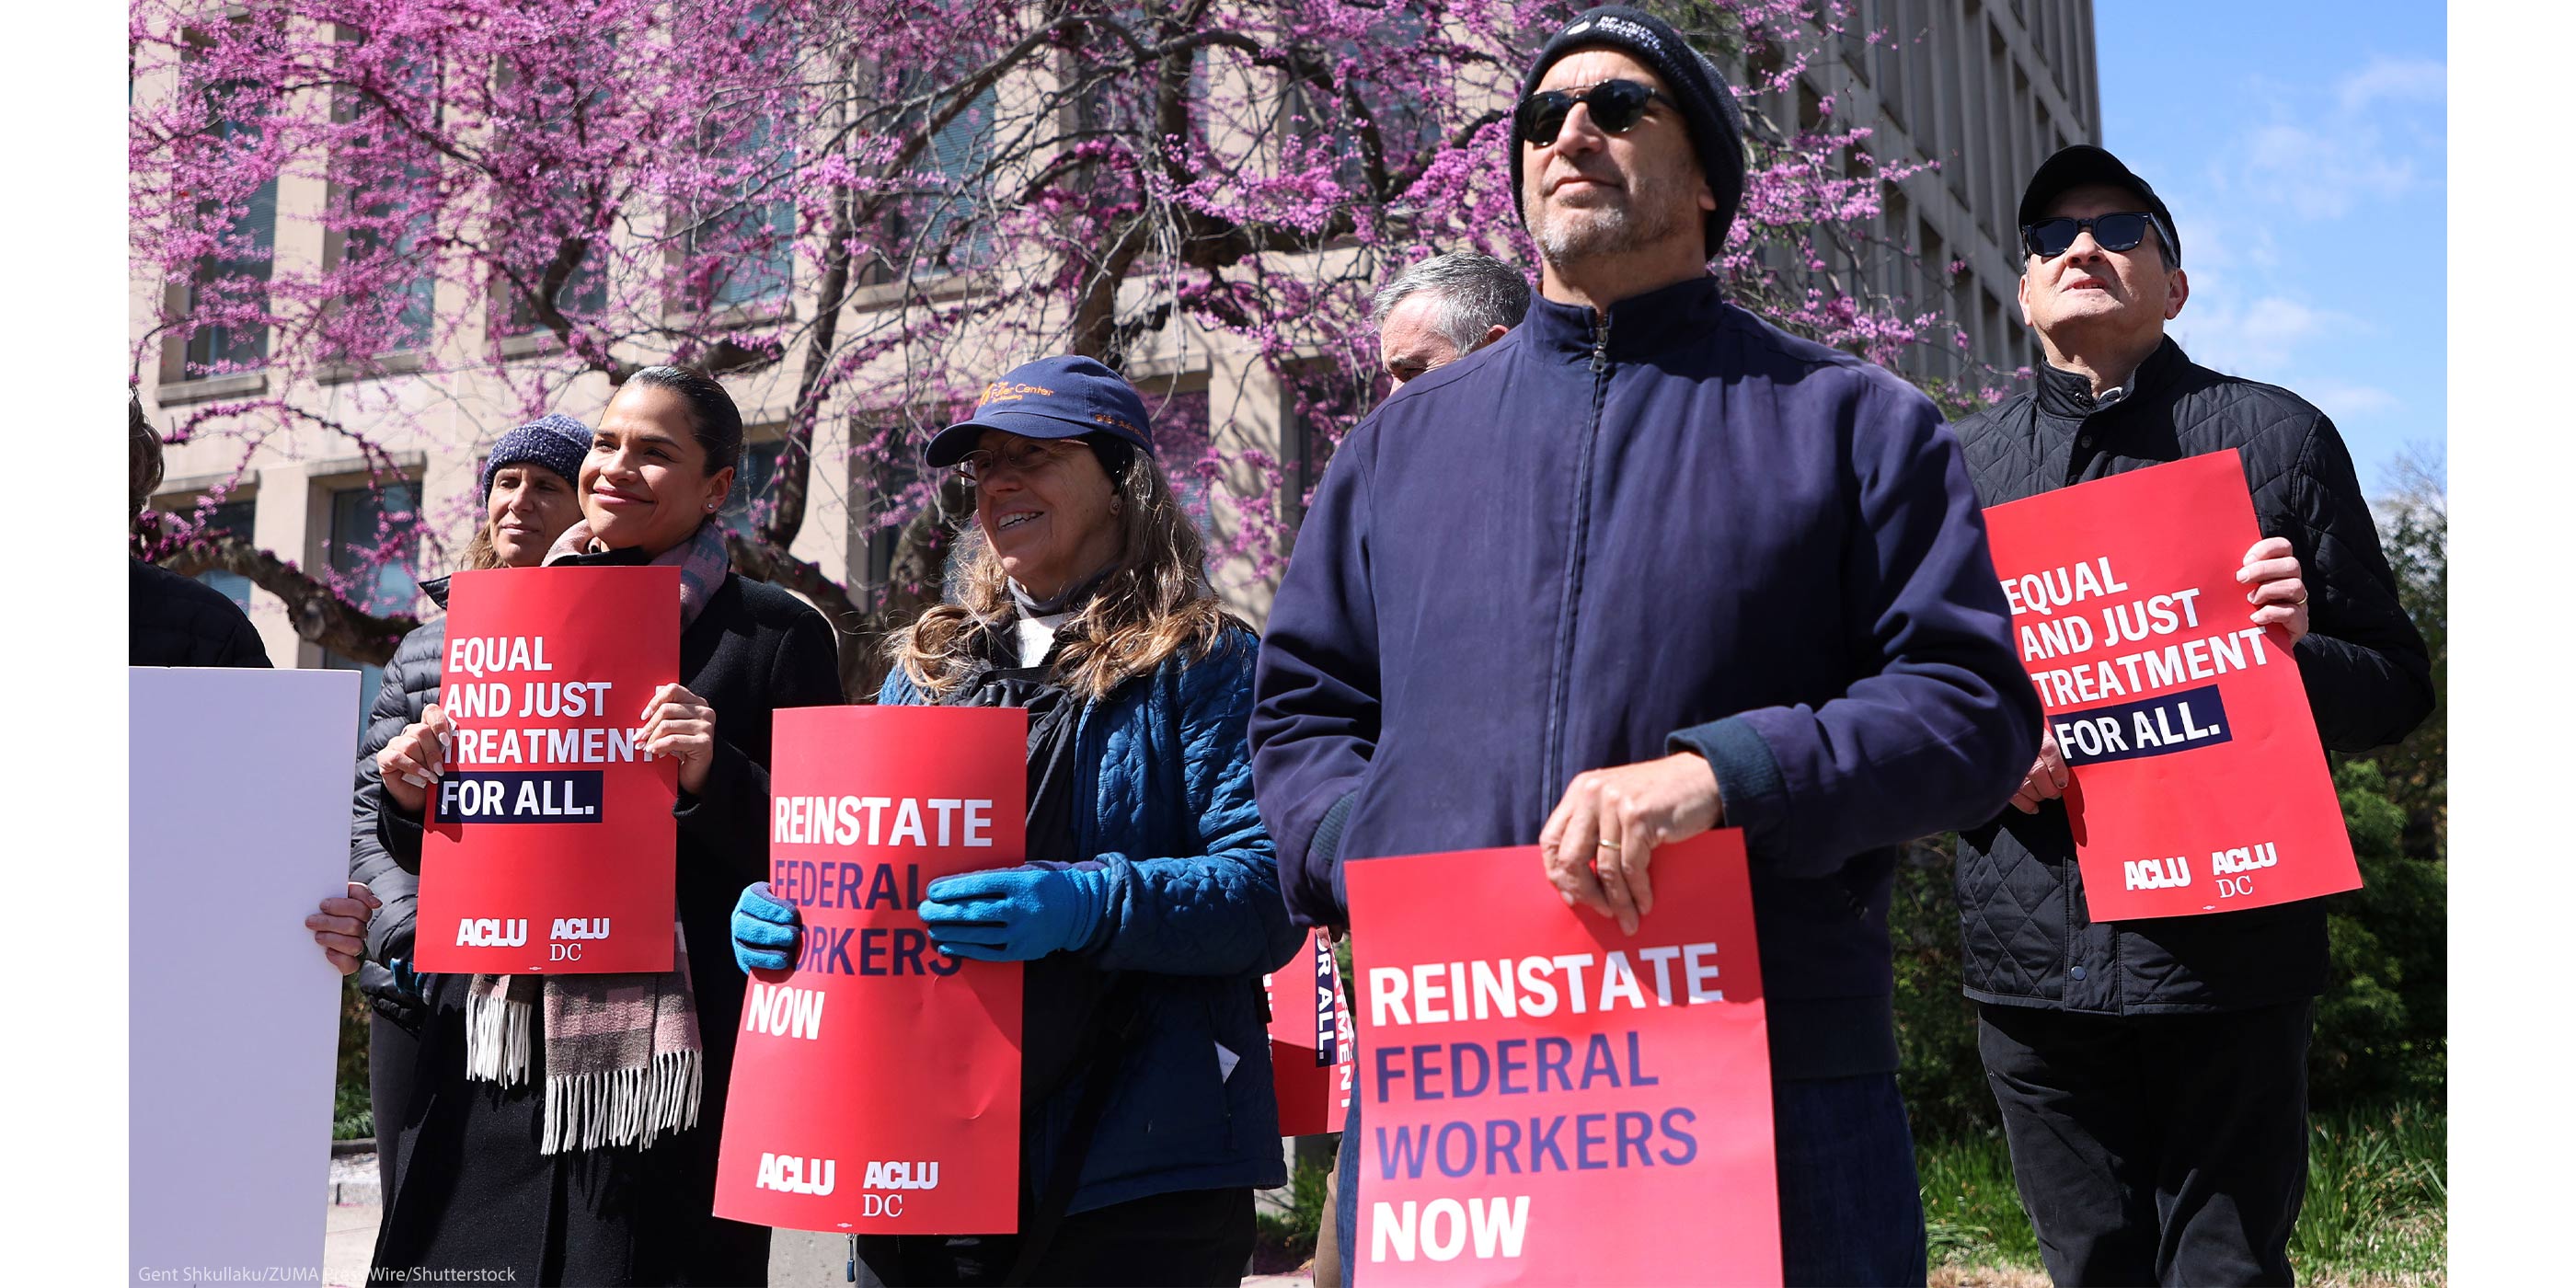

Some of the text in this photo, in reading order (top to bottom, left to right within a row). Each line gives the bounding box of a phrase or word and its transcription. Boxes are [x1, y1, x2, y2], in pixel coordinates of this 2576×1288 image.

[1015, 383, 1054, 397] Center
[1999, 556, 2129, 615] EQUAL
[2020, 588, 2201, 662] AND JUST
[448, 636, 553, 679] EQUAL
[2030, 626, 2270, 708] TREATMENT
[443, 682, 612, 719] AND JUST
[2053, 701, 2221, 760] FOR ALL.
[441, 779, 594, 816] FOR ALL.
[774, 795, 993, 847] REINSTATE
[2123, 856, 2191, 891] ACLU
[2212, 842, 2278, 876] ACLU
[2215, 876, 2253, 899] DC
[456, 918, 527, 948] ACLU
[550, 917, 610, 940] ACLU
[549, 944, 581, 961] DC
[1368, 942, 1723, 1027] REINSTATE
[746, 983, 824, 1041] NOW
[1317, 986, 1334, 1060] ALL.
[1374, 1030, 1660, 1103] FEDERAL
[1375, 1108, 1699, 1181] WORKERS
[755, 1152, 835, 1197] ACLU
[863, 1160, 939, 1190] ACLU
[862, 1194, 903, 1219] DC
[1370, 1195, 1531, 1264] NOW
